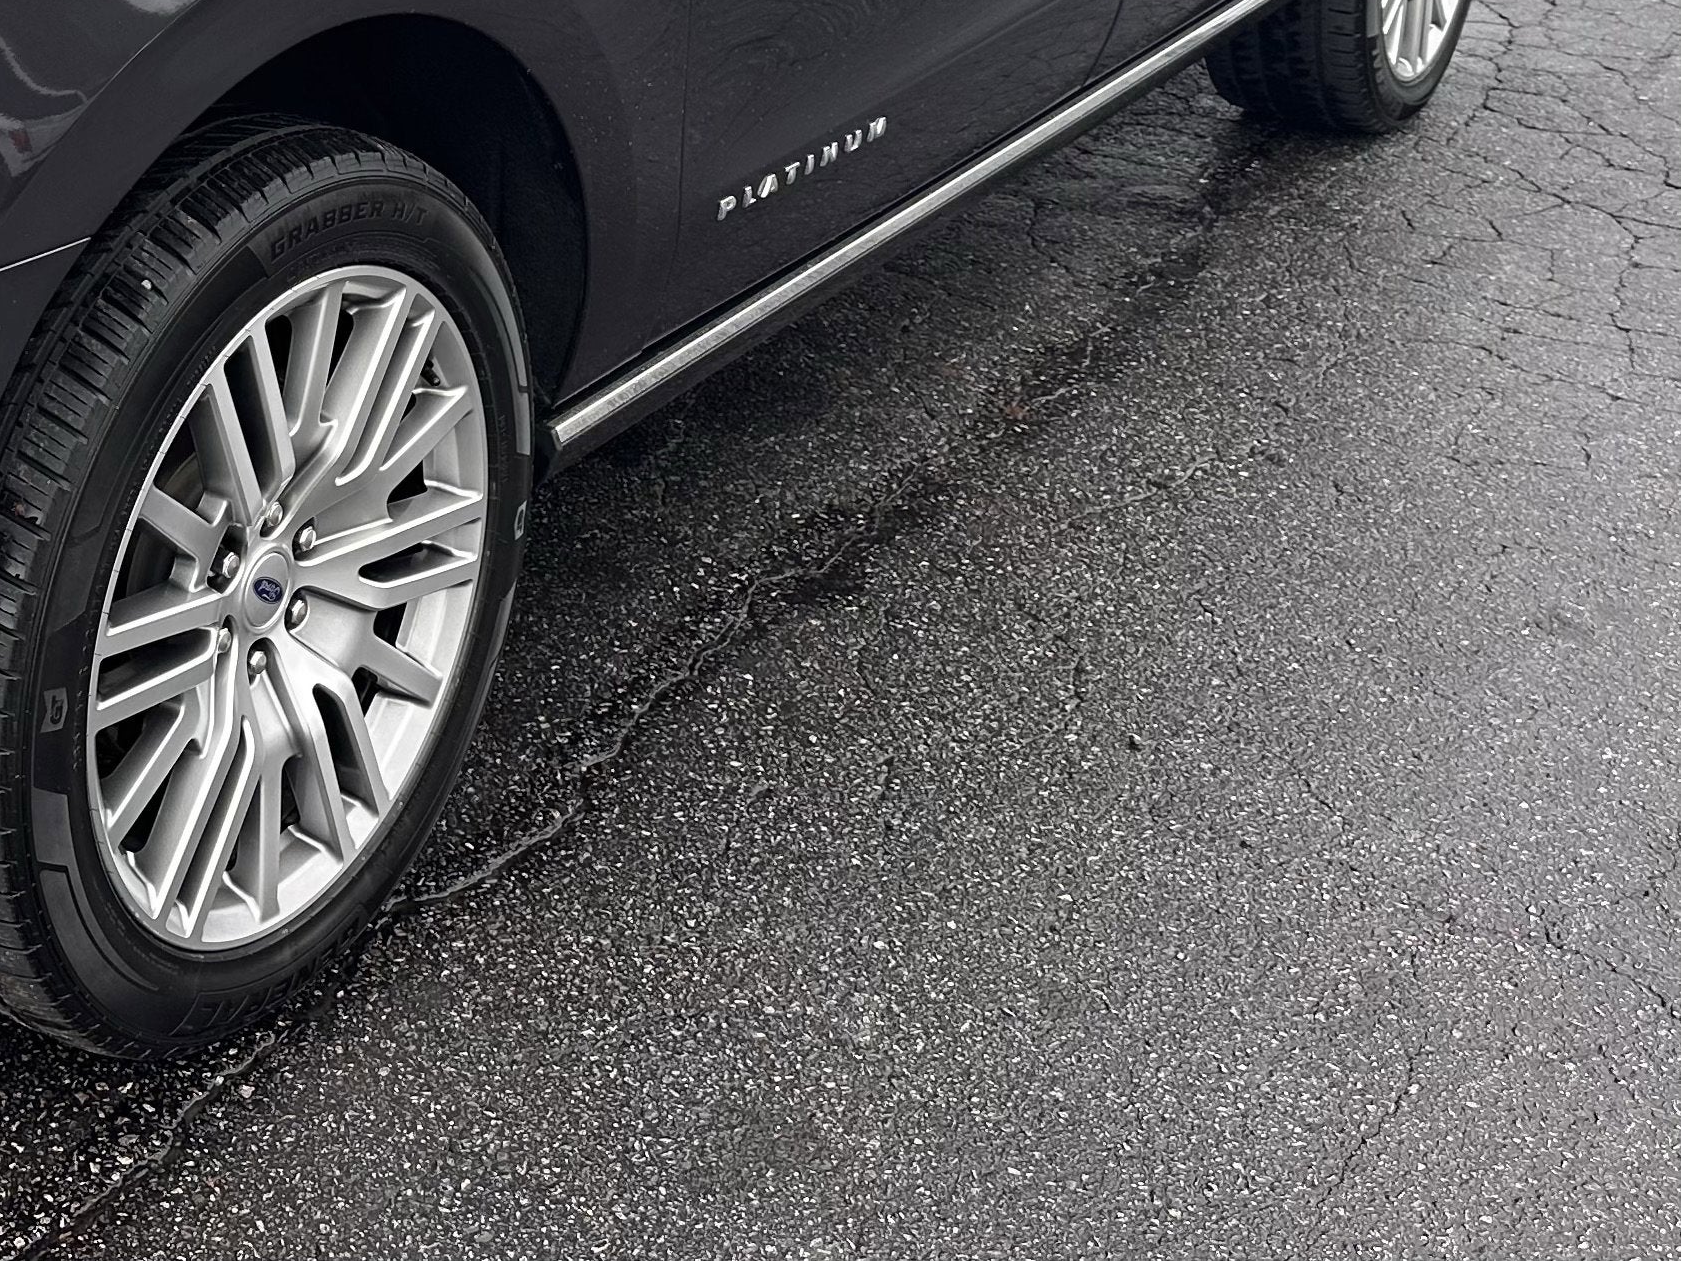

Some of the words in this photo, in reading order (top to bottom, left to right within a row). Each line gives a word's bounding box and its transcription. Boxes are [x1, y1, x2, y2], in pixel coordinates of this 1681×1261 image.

[717, 116, 886, 221] PLATINUM
[270, 200, 384, 264] GRABBER
[392, 201, 430, 225] H/T
